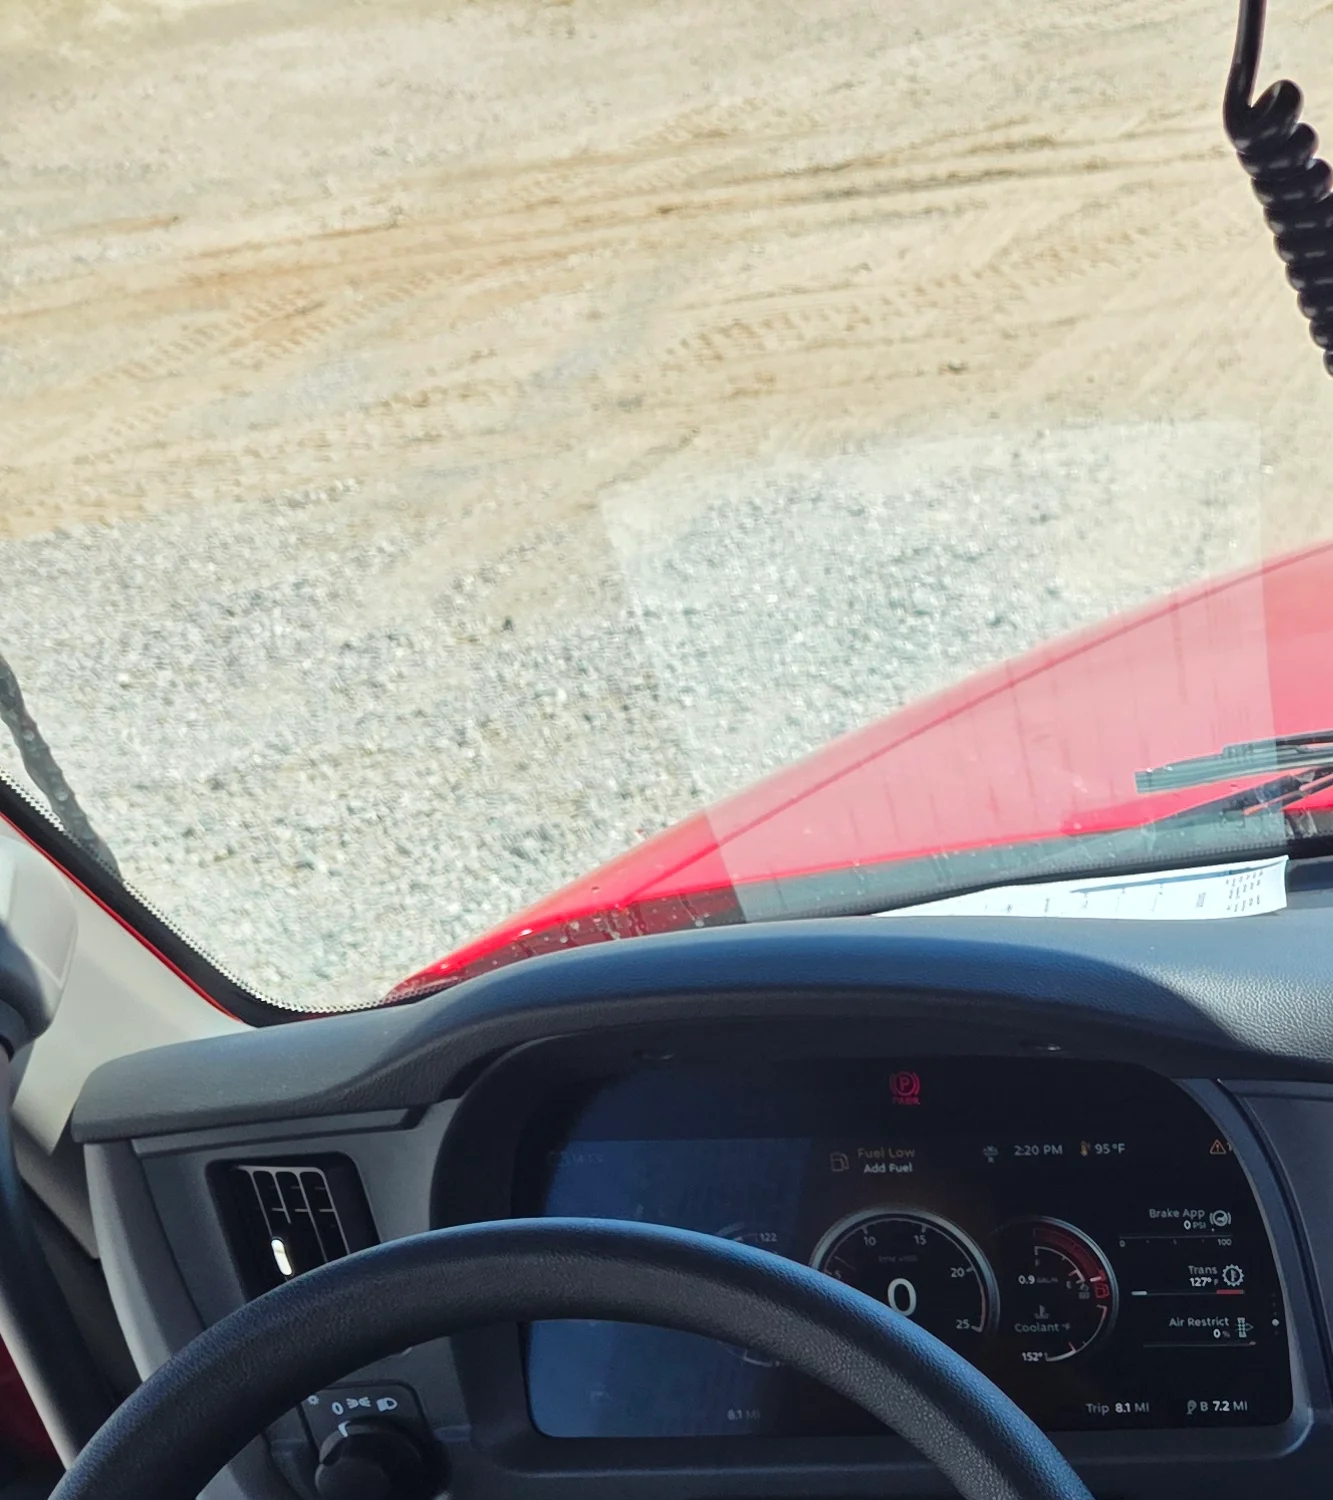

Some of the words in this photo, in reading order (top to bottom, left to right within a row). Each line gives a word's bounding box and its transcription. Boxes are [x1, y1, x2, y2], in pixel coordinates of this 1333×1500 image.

[857, 1147, 885, 1159] Fuel
[889, 1147, 916, 1159] Low
[1013, 1144, 1040, 1156] 2:20
[1043, 1144, 1064, 1156] PM
[863, 1163, 885, 1174] Add
[889, 1162, 913, 1174] Fuel
[1149, 1207, 1180, 1219] Brake
[1183, 1208, 1206, 1221] App
[863, 1235, 877, 1247] 10
[914, 1235, 928, 1247] 15
[950, 1267, 966, 1279] 20
[1188, 1265, 1218, 1275] Trans
[1018, 1275, 1035, 1285] 0.9
[887, 1278, 917, 1317] 0
[955, 1319, 970, 1331] 25
[1014, 1322, 1060, 1333] Coolant
[1169, 1317, 1184, 1328] Air
[1187, 1316, 1231, 1328] Restrict
[1213, 1328, 1221, 1339] 0
[1085, 1402, 1110, 1416] Trip
[1114, 1402, 1131, 1413] 8.1
[1134, 1402, 1150, 1413] MI
[1212, 1401, 1230, 1411] 7.2
[1233, 1401, 1248, 1411] MI
